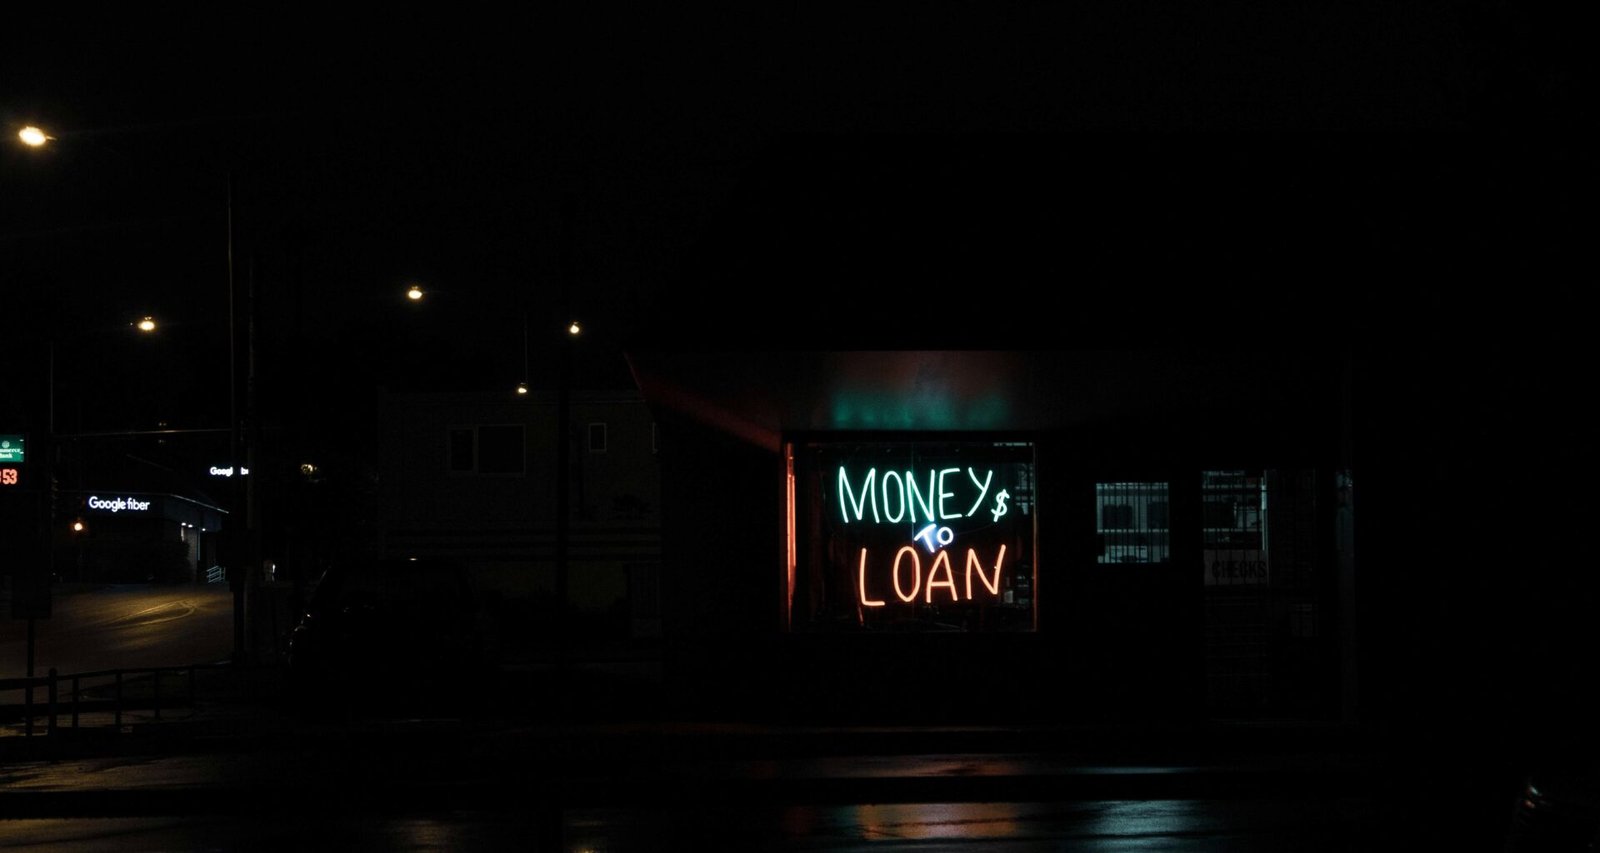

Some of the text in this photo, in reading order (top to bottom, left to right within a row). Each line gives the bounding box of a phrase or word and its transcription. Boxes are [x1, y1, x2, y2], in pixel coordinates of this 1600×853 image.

[0, 469, 18, 485] 53
[209, 466, 234, 476] Googl
[88, 496, 151, 512] Google fiber
[838, 466, 1010, 524] MONEY $
[914, 524, 954, 553] TO
[859, 543, 1007, 606] LOAN
[1211, 560, 1267, 578] CHECKS
